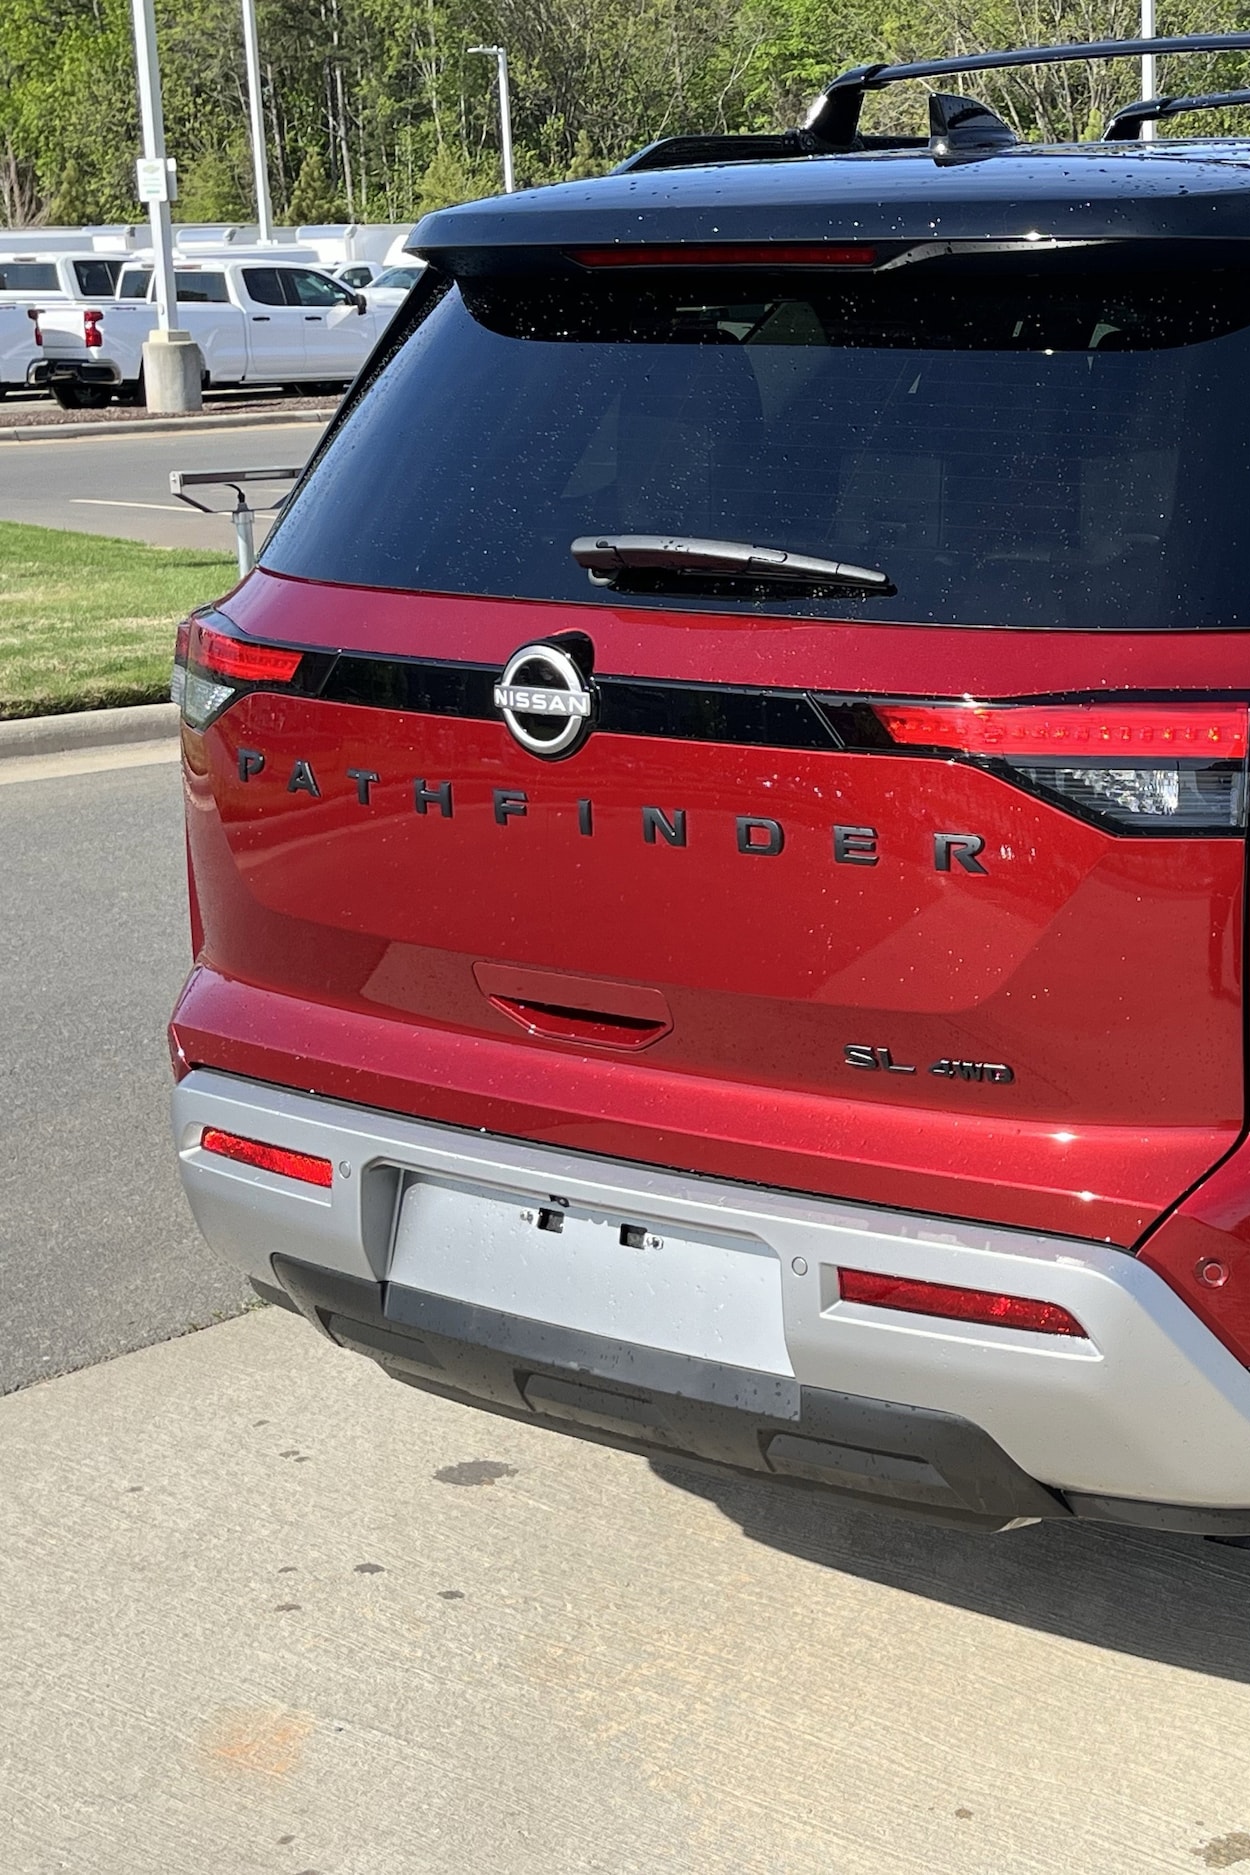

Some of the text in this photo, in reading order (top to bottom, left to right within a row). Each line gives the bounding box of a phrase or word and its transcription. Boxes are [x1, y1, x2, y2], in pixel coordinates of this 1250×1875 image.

[494, 687, 587, 714] NISSAN
[238, 748, 988, 875] PATHFINDER
[844, 1044, 1016, 1084] SL 4WD
